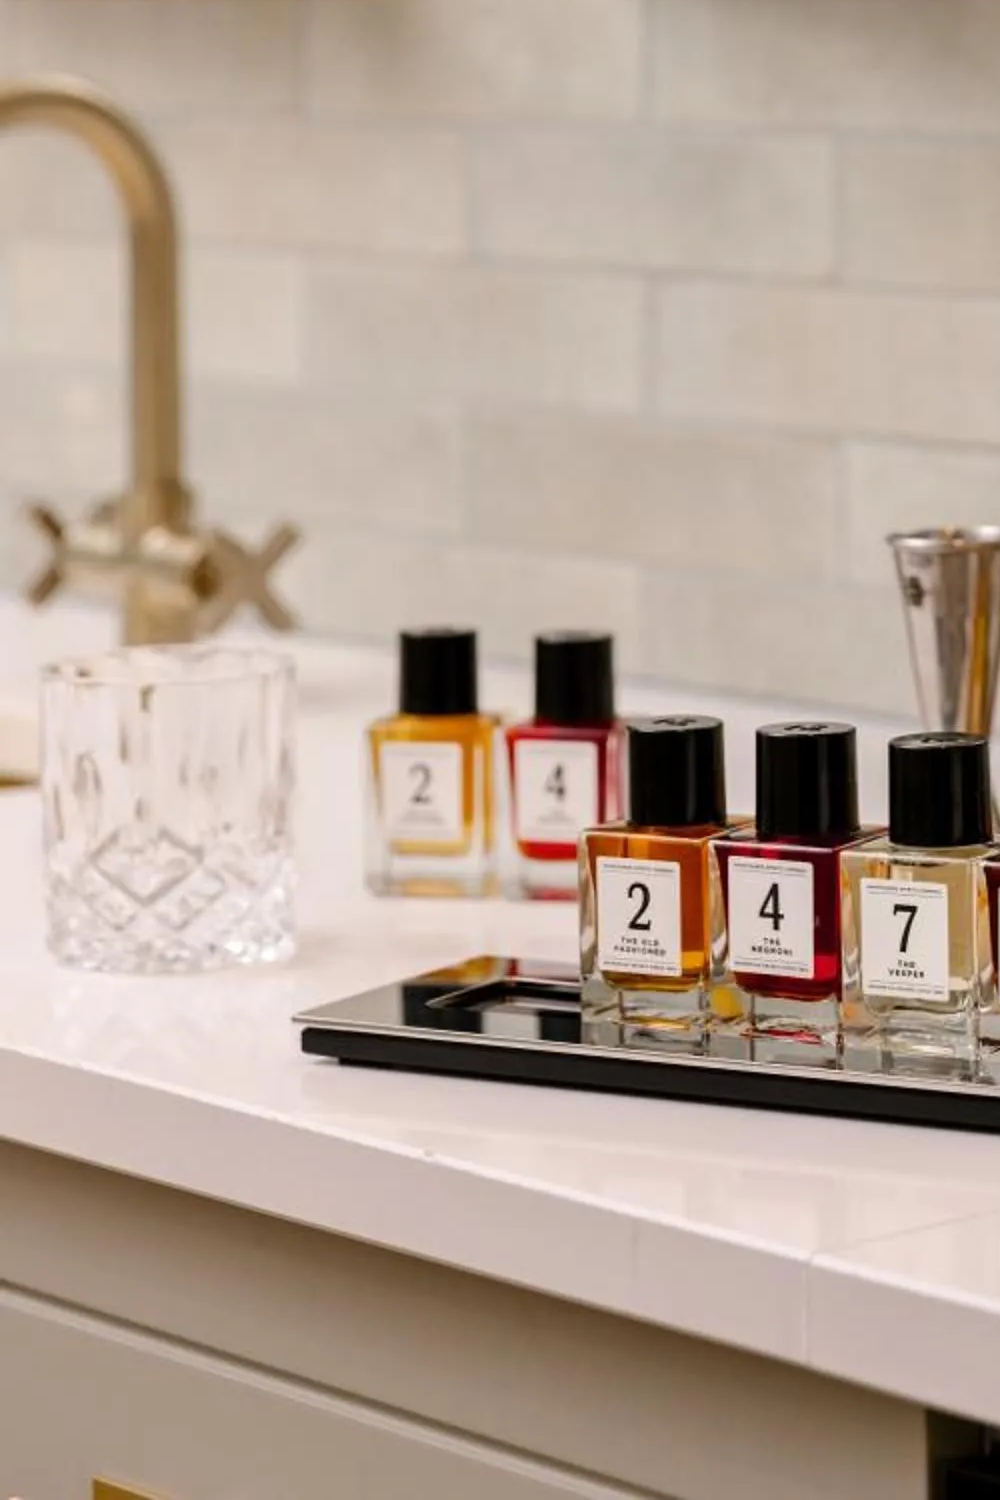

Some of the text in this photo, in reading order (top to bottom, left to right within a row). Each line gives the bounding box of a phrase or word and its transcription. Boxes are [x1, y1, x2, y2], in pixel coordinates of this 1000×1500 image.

[408, 763, 433, 804] 2
[545, 764, 567, 801] 4
[626, 881, 653, 931] 2
[758, 882, 785, 931] 4
[892, 903, 919, 953] 7
[621, 936, 661, 947] THE OLD
[763, 937, 781, 947] THE
[613, 944, 667, 957] FASHIONED
[751, 945, 794, 957] NEGRONI
[898, 959, 917, 969] THE
[887, 968, 926, 980] VESPER
